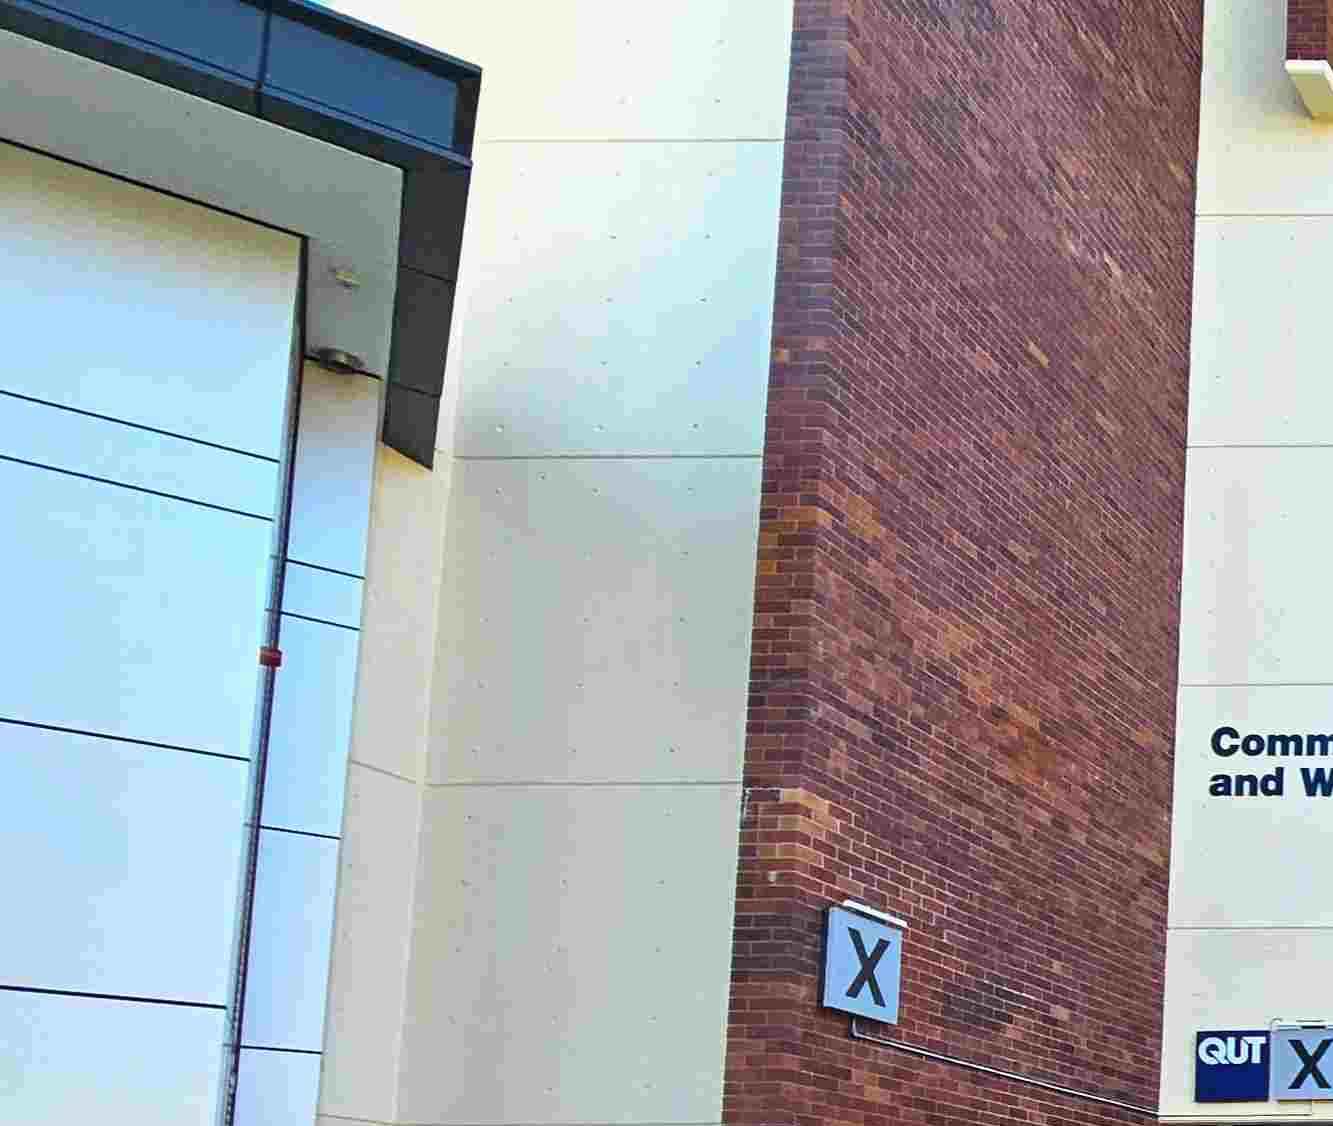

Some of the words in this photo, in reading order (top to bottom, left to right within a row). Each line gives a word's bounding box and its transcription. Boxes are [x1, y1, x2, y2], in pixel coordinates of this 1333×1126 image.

[1208, 767, 1284, 798] and
[845, 926, 892, 1008] X
[1198, 1036, 1267, 1065] QUT
